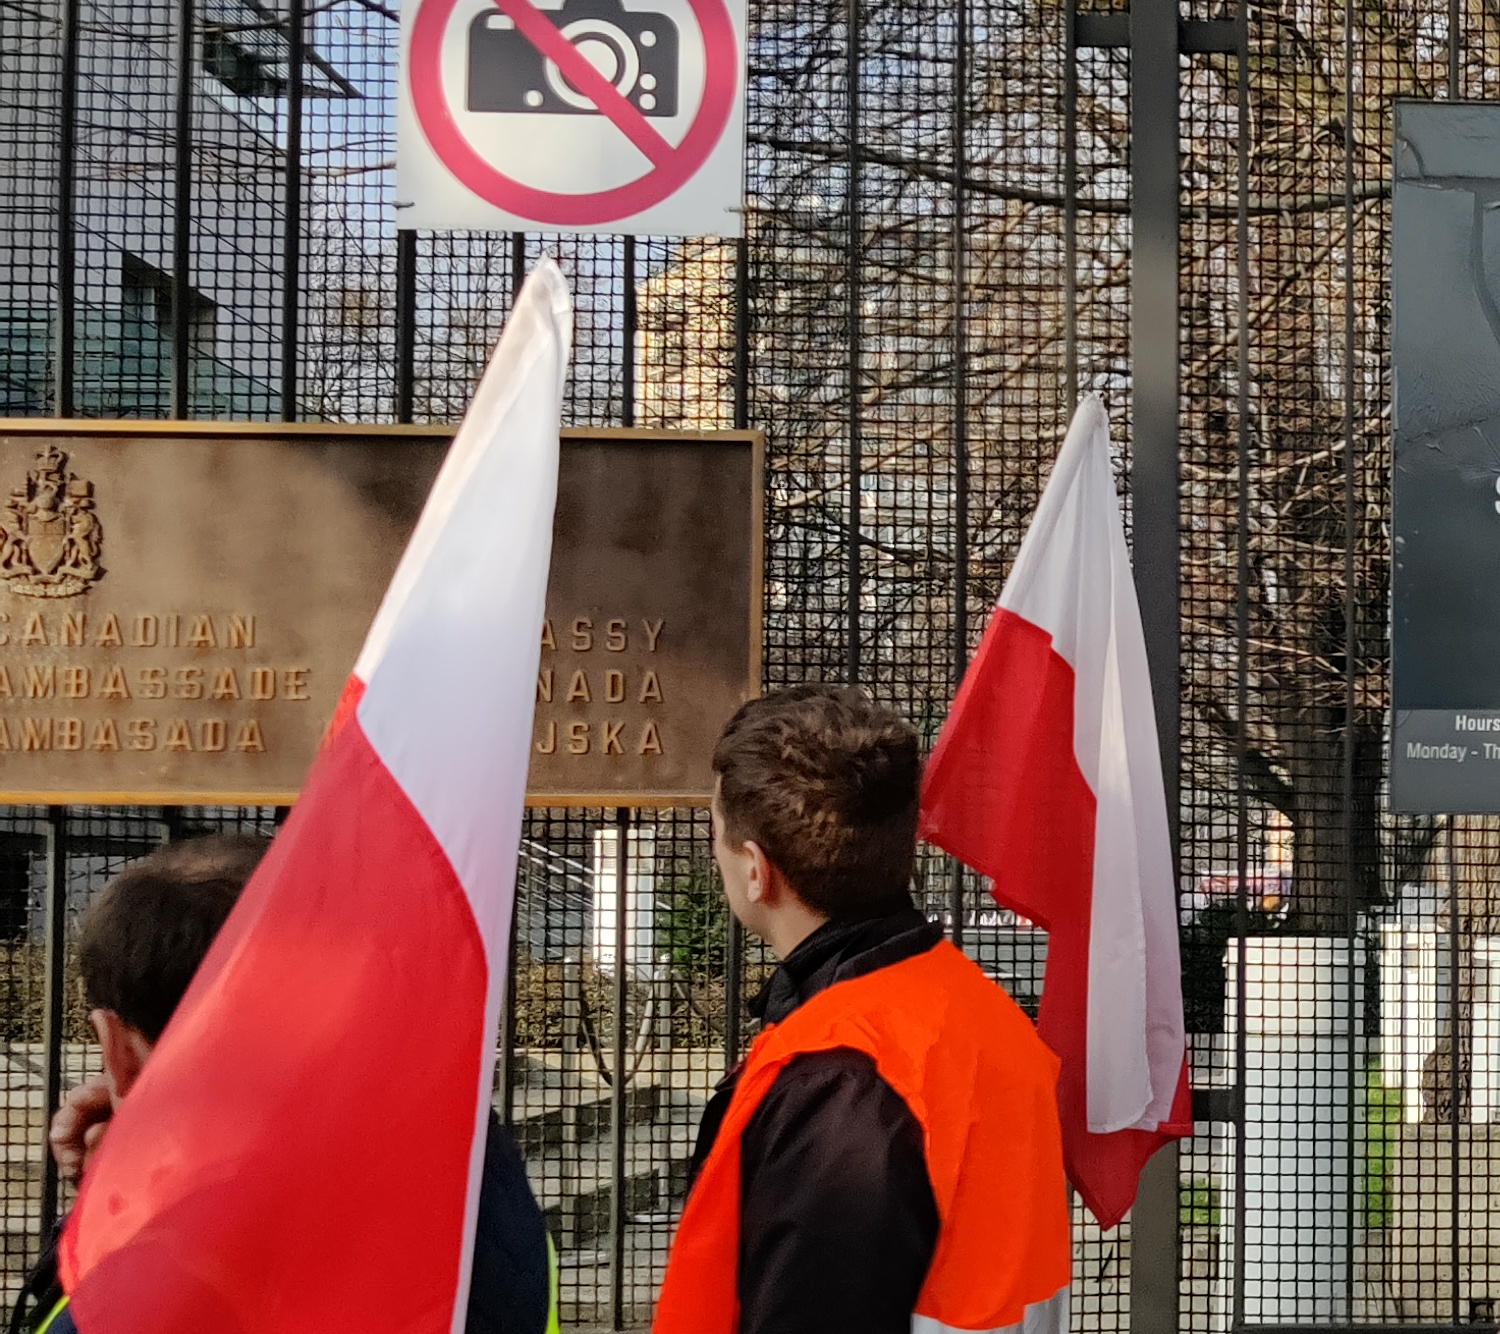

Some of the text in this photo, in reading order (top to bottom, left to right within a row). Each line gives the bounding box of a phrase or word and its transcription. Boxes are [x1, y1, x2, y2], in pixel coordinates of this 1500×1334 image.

[541, 617, 666, 652] ASSY
[537, 668, 664, 703] NADA
[1406, 742, 1467, 763] Monday
